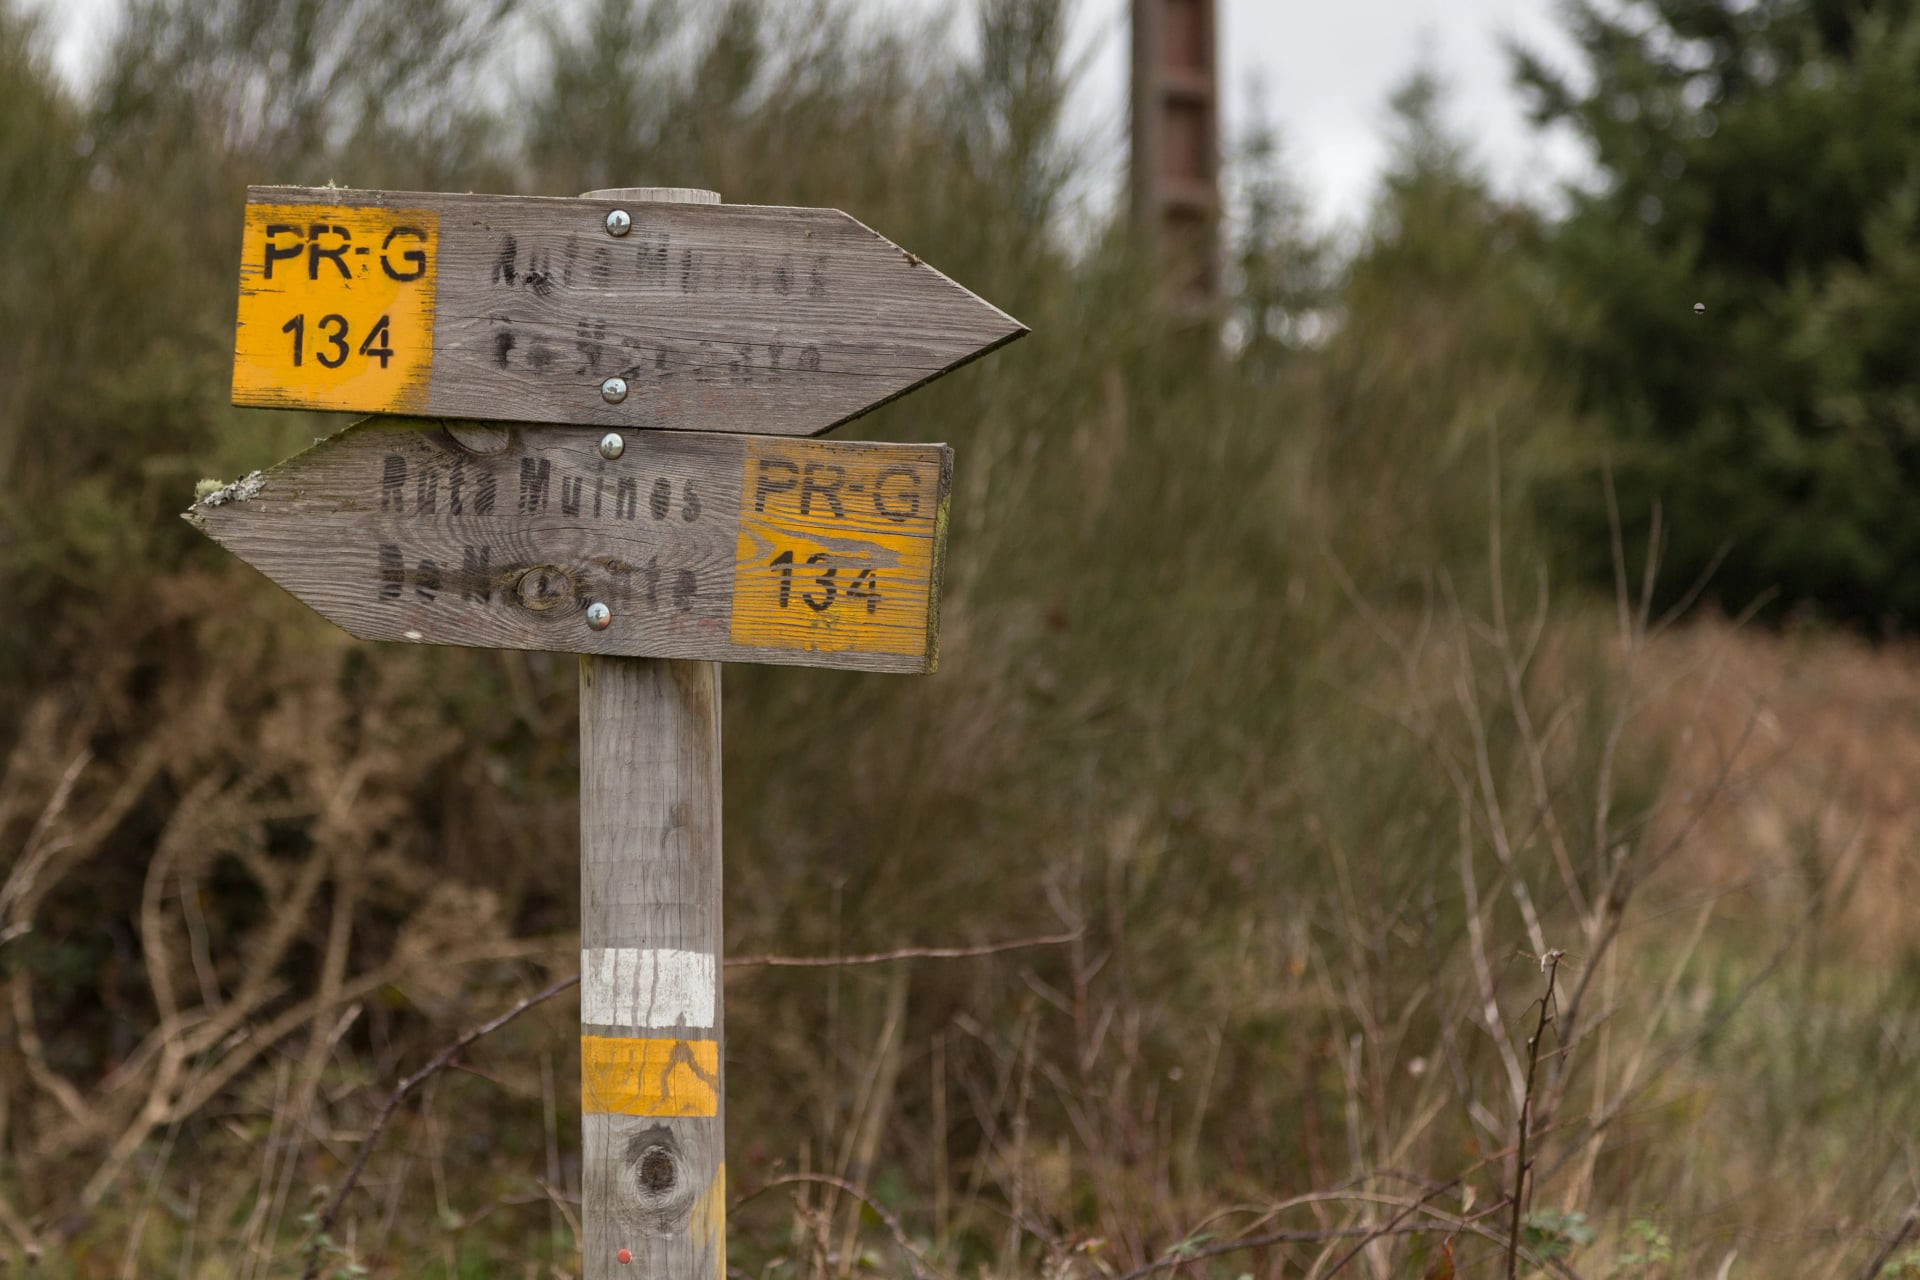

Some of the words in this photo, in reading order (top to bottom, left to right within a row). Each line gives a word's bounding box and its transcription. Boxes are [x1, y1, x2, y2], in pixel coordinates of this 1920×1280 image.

[264, 224, 428, 281] PR-G
[282, 313, 394, 368] 134
[755, 458, 921, 522] PR-G
[769, 551, 882, 614] 134
